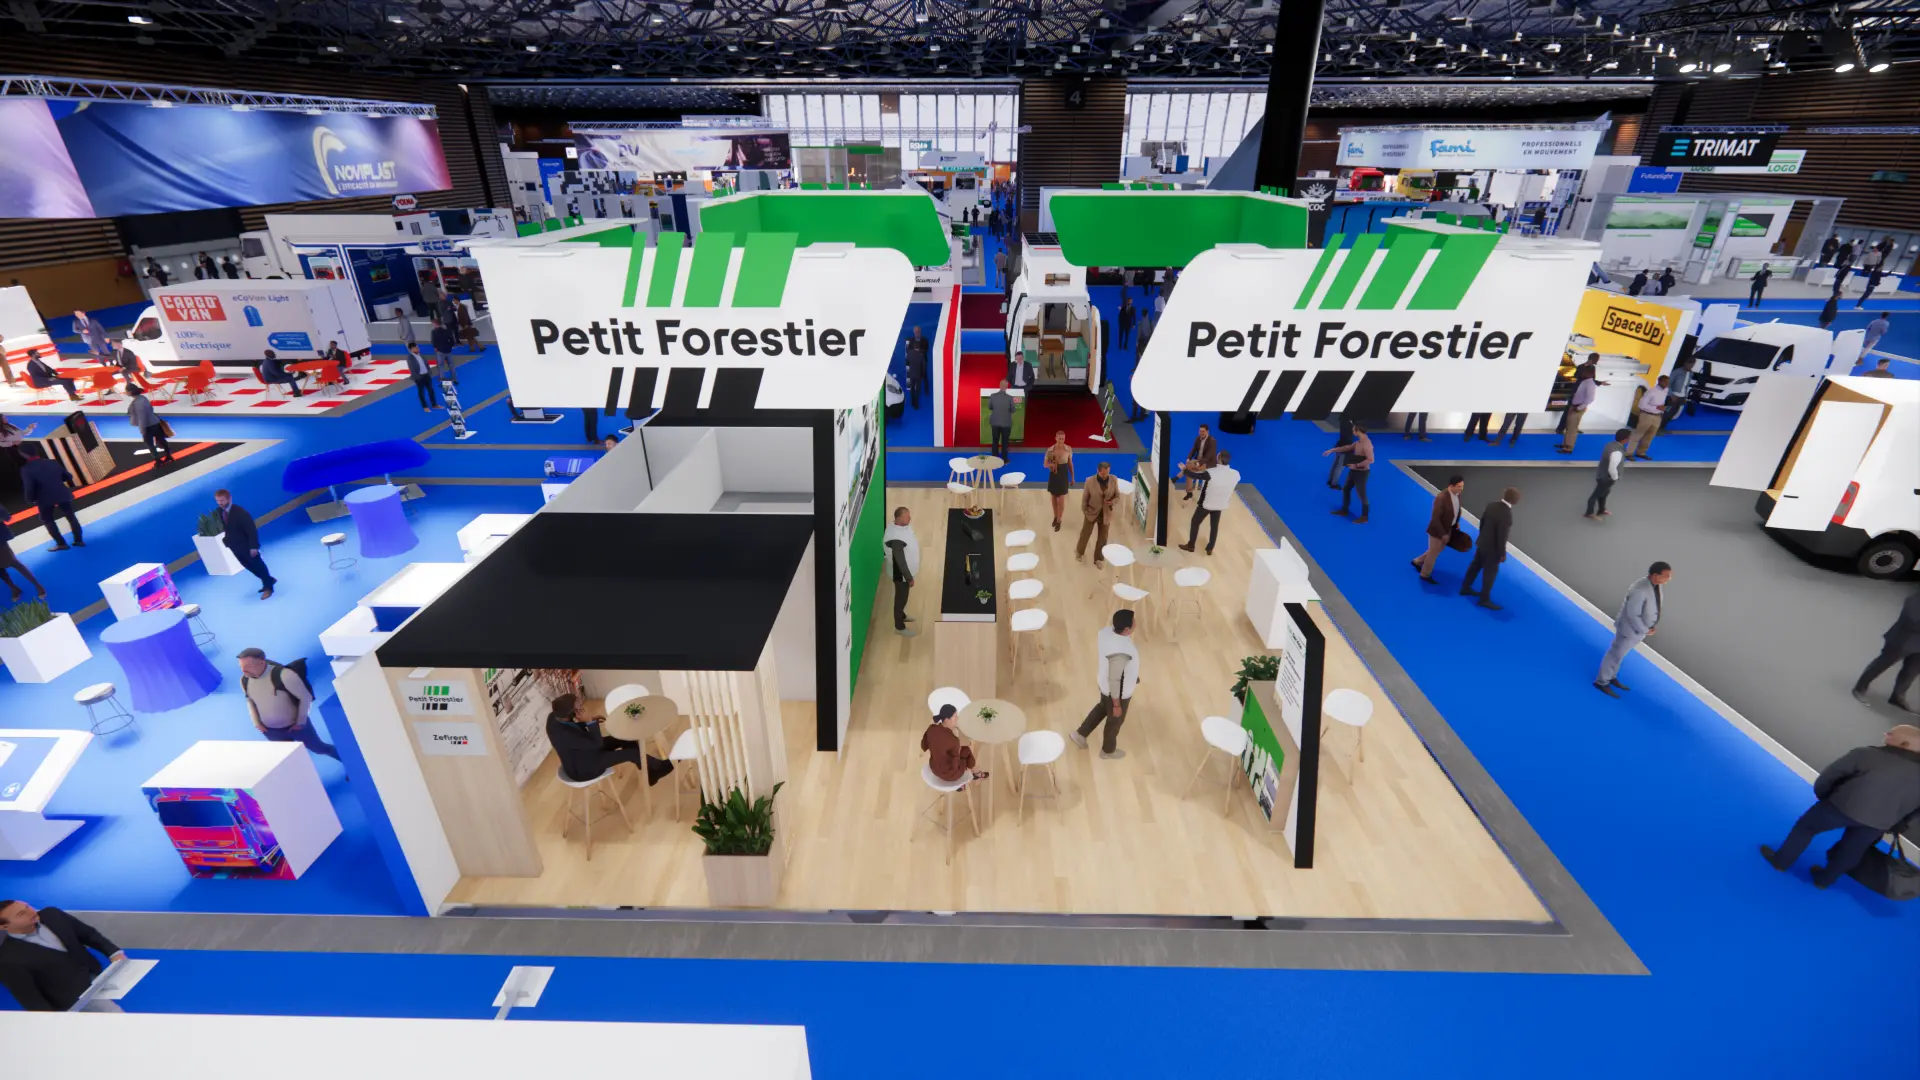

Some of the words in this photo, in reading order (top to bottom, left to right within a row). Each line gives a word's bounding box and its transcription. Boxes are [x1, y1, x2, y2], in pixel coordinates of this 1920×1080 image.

[1070, 91, 1081, 104] 4
[1692, 139, 1760, 157] TRIMAT
[1767, 164, 1797, 173] LOGO
[162, 296, 216, 309] CARGO
[268, 294, 290, 303] Light
[177, 308, 212, 321] VAN
[530, 318, 644, 356] Petit
[656, 319, 866, 357] Forestier
[1187, 320, 1301, 358] Petit
[1313, 321, 1534, 360] Forestier
[180, 340, 232, 351] électrique
